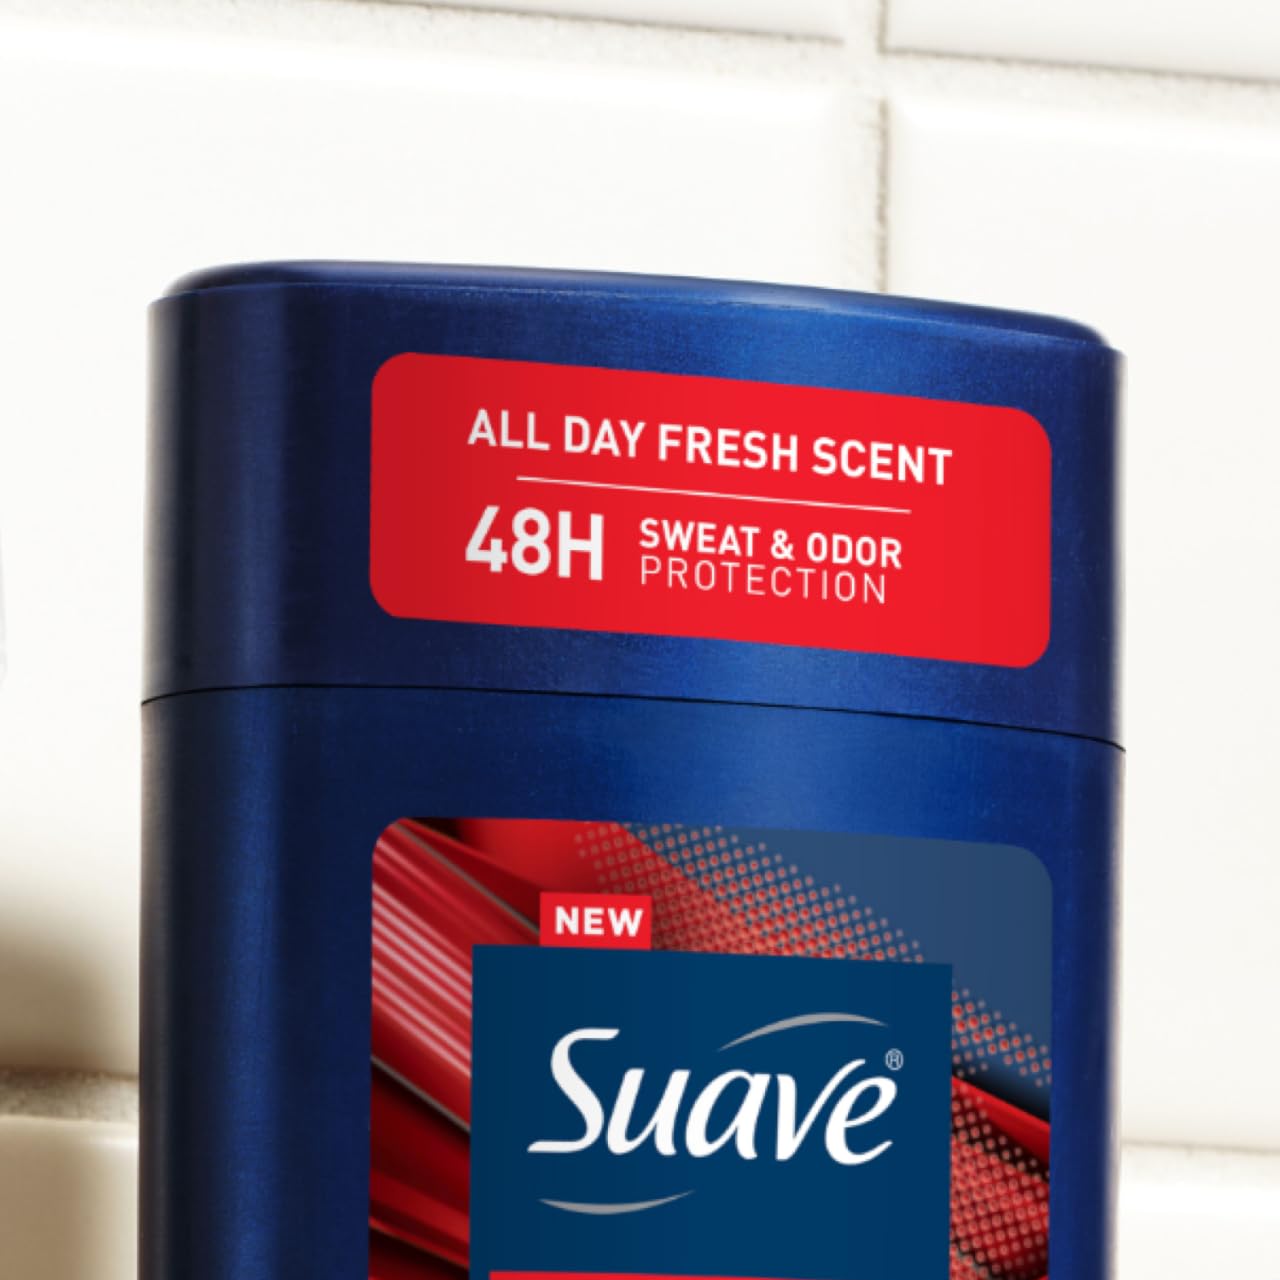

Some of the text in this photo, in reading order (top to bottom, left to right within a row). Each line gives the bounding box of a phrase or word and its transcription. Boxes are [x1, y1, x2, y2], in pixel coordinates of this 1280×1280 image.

[467, 408, 952, 485] ALL DAY FRESH SCENT
[465, 505, 604, 581] 48H
[638, 518, 902, 569] SWEAT & ODOR
[640, 556, 886, 605] PROTECTION
[554, 906, 644, 937] NEW
